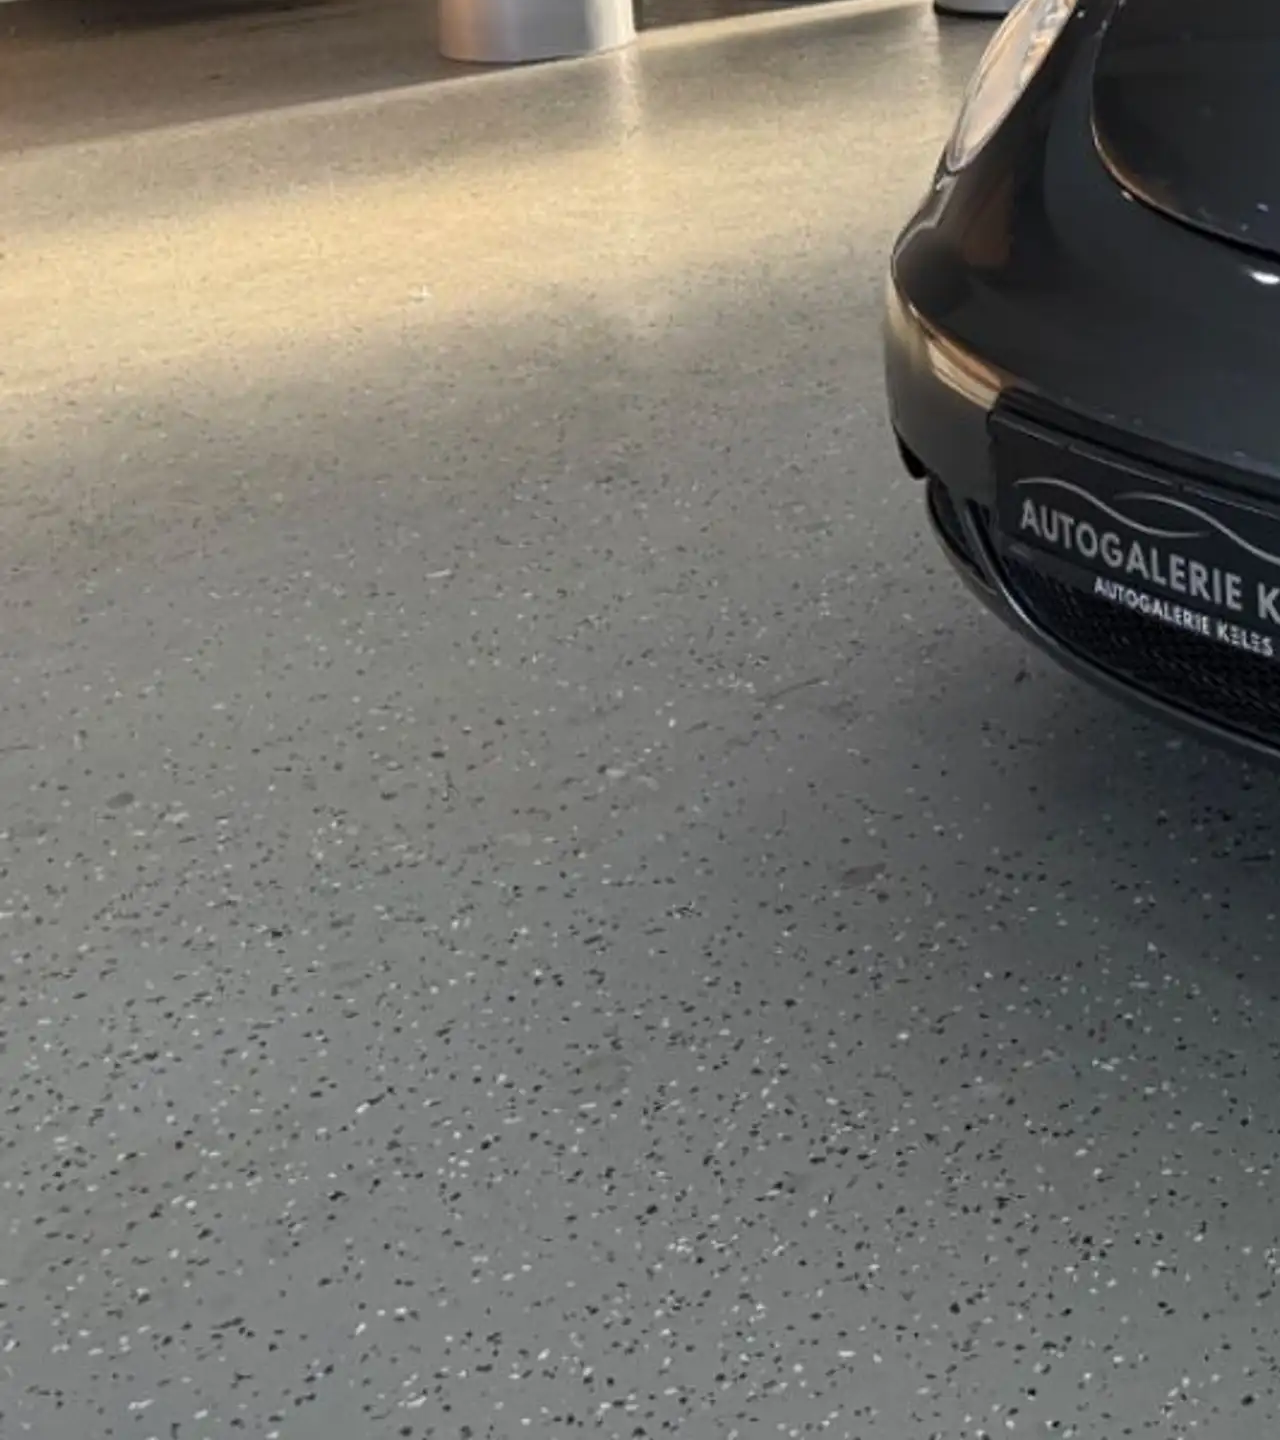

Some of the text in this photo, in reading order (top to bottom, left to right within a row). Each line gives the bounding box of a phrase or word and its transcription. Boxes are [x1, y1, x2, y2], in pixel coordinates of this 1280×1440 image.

[1020, 498, 1243, 612] AUTOGALERIE
[1093, 575, 1274, 658] AUTOGALERIE KELES
